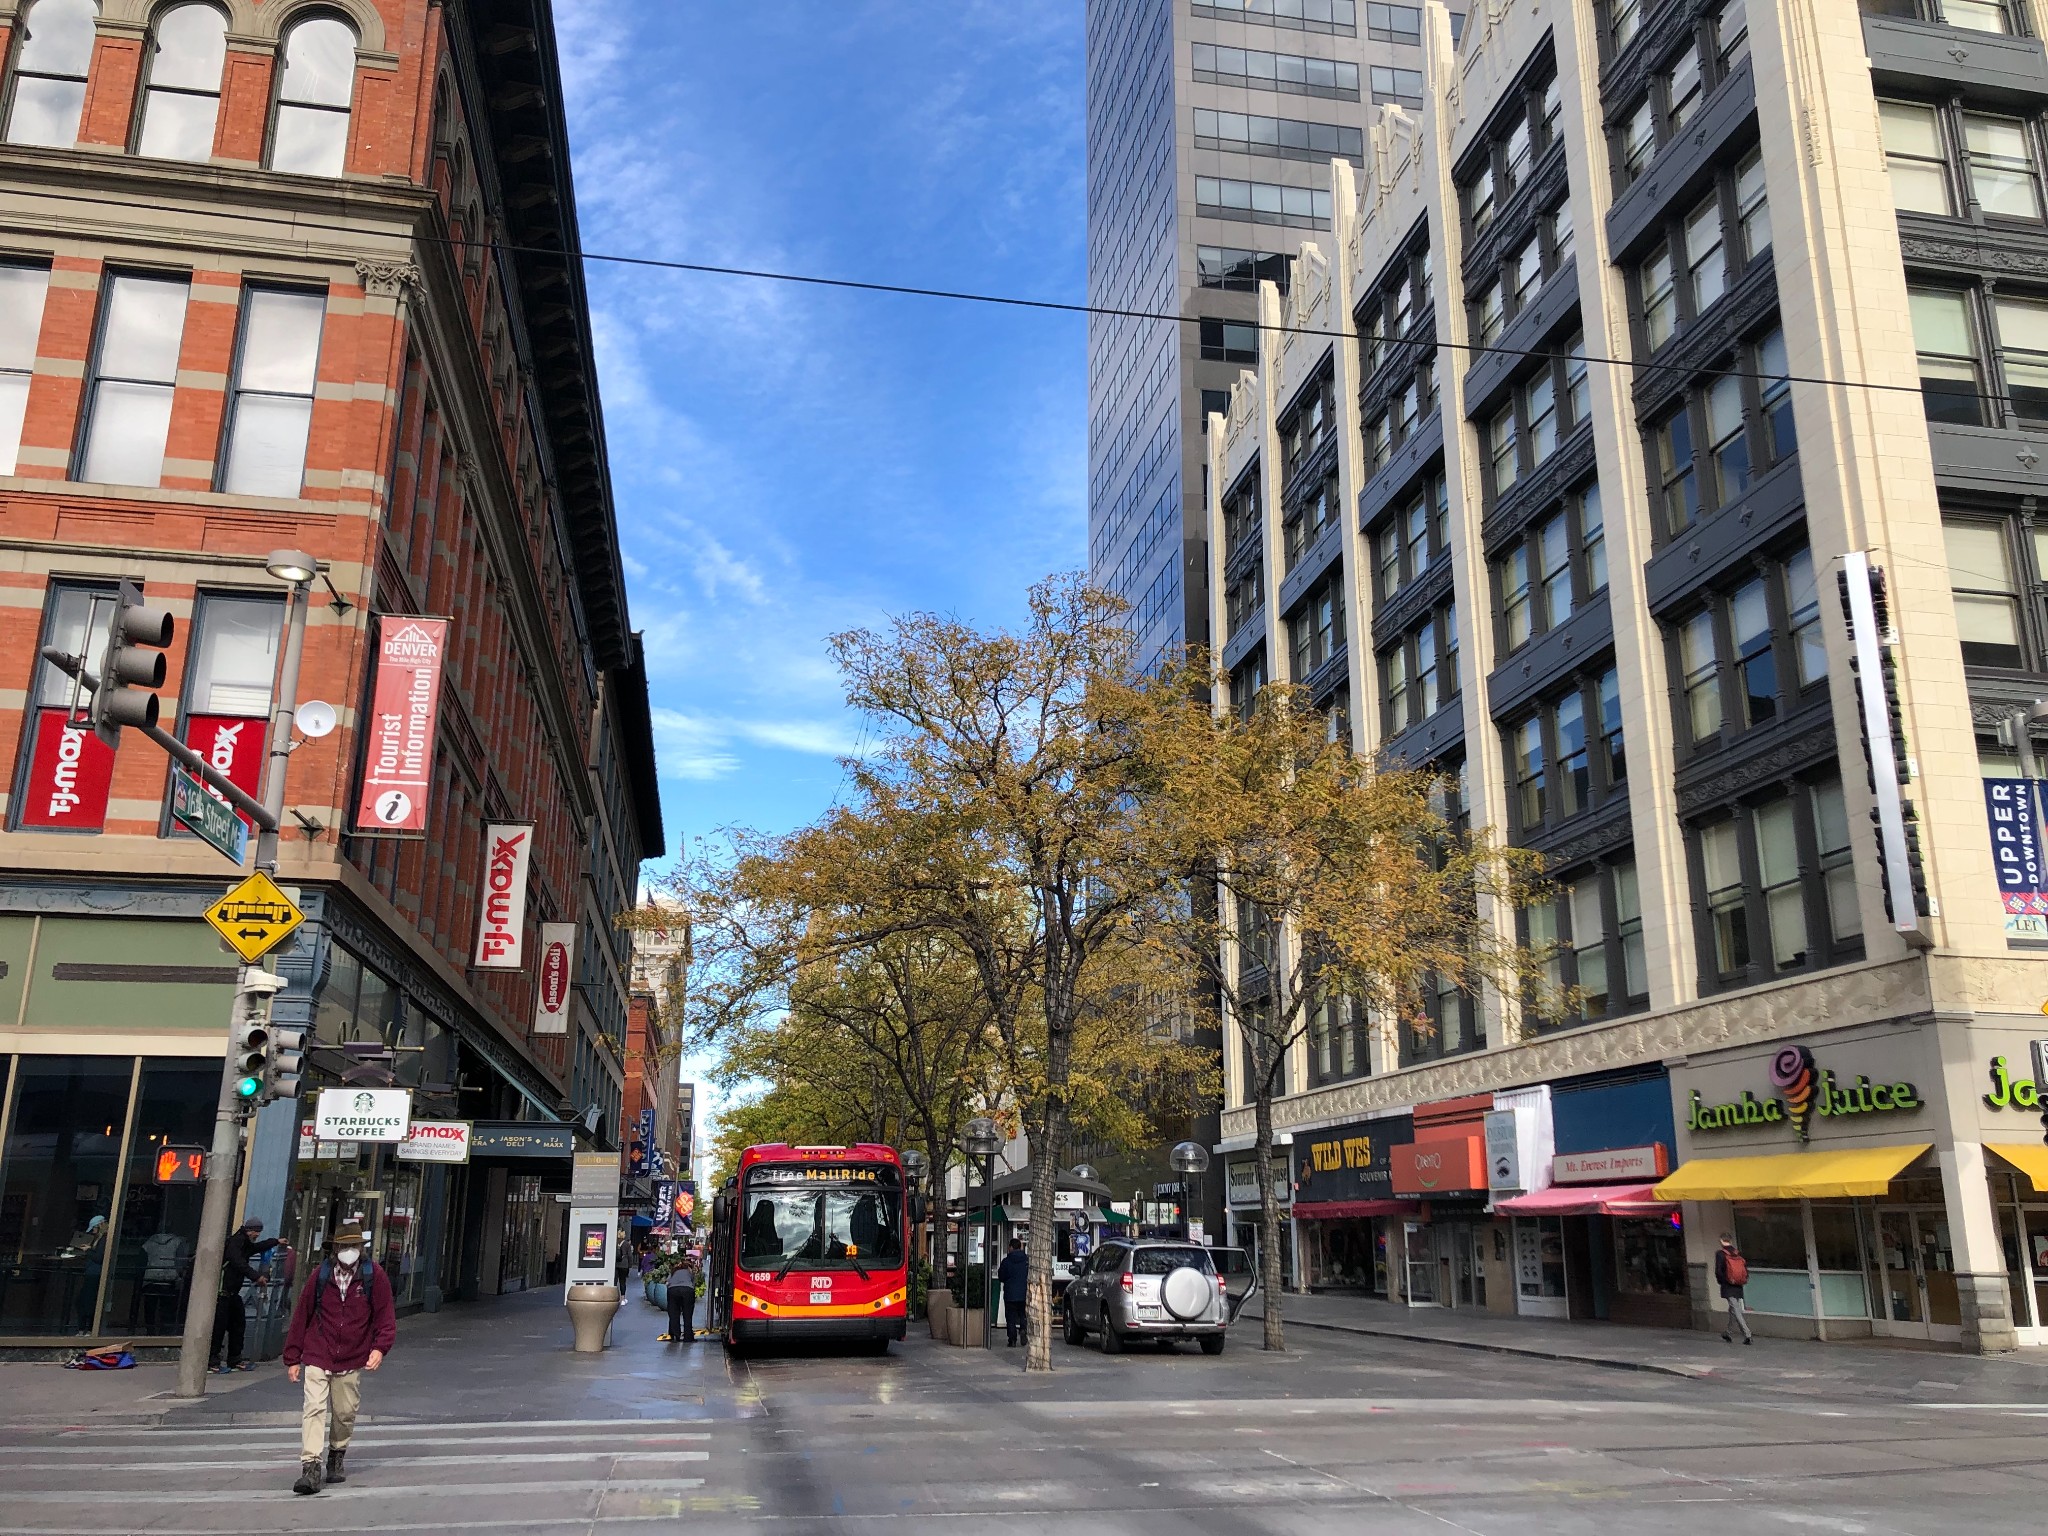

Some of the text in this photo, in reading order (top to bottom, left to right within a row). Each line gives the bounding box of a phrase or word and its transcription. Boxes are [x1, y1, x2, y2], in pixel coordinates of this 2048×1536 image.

[384, 641, 438, 657] DENVER
[399, 668, 433, 776] Information
[374, 713, 403, 776] Tourist
[204, 803, 232, 844] Street
[1992, 784, 2023, 885] UPPER
[2015, 784, 2039, 884] DOWNTOWN
[2014, 919, 2038, 931] LEI
[551, 947, 561, 971] deli
[324, 1116, 401, 1126] STARBUCKS
[1684, 1088, 1783, 1131] jamba
[337, 1127, 386, 1136] COFFEE
[1311, 1140, 1342, 1172] WILD
[1565, 1157, 1643, 1173] Mt. Everest Imports
[1359, 1170, 1388, 1182] SOUVENIR
[655, 1185, 667, 1221] UPPER
[749, 1272, 771, 1282] 1659
[811, 1276, 832, 1289] RTD
